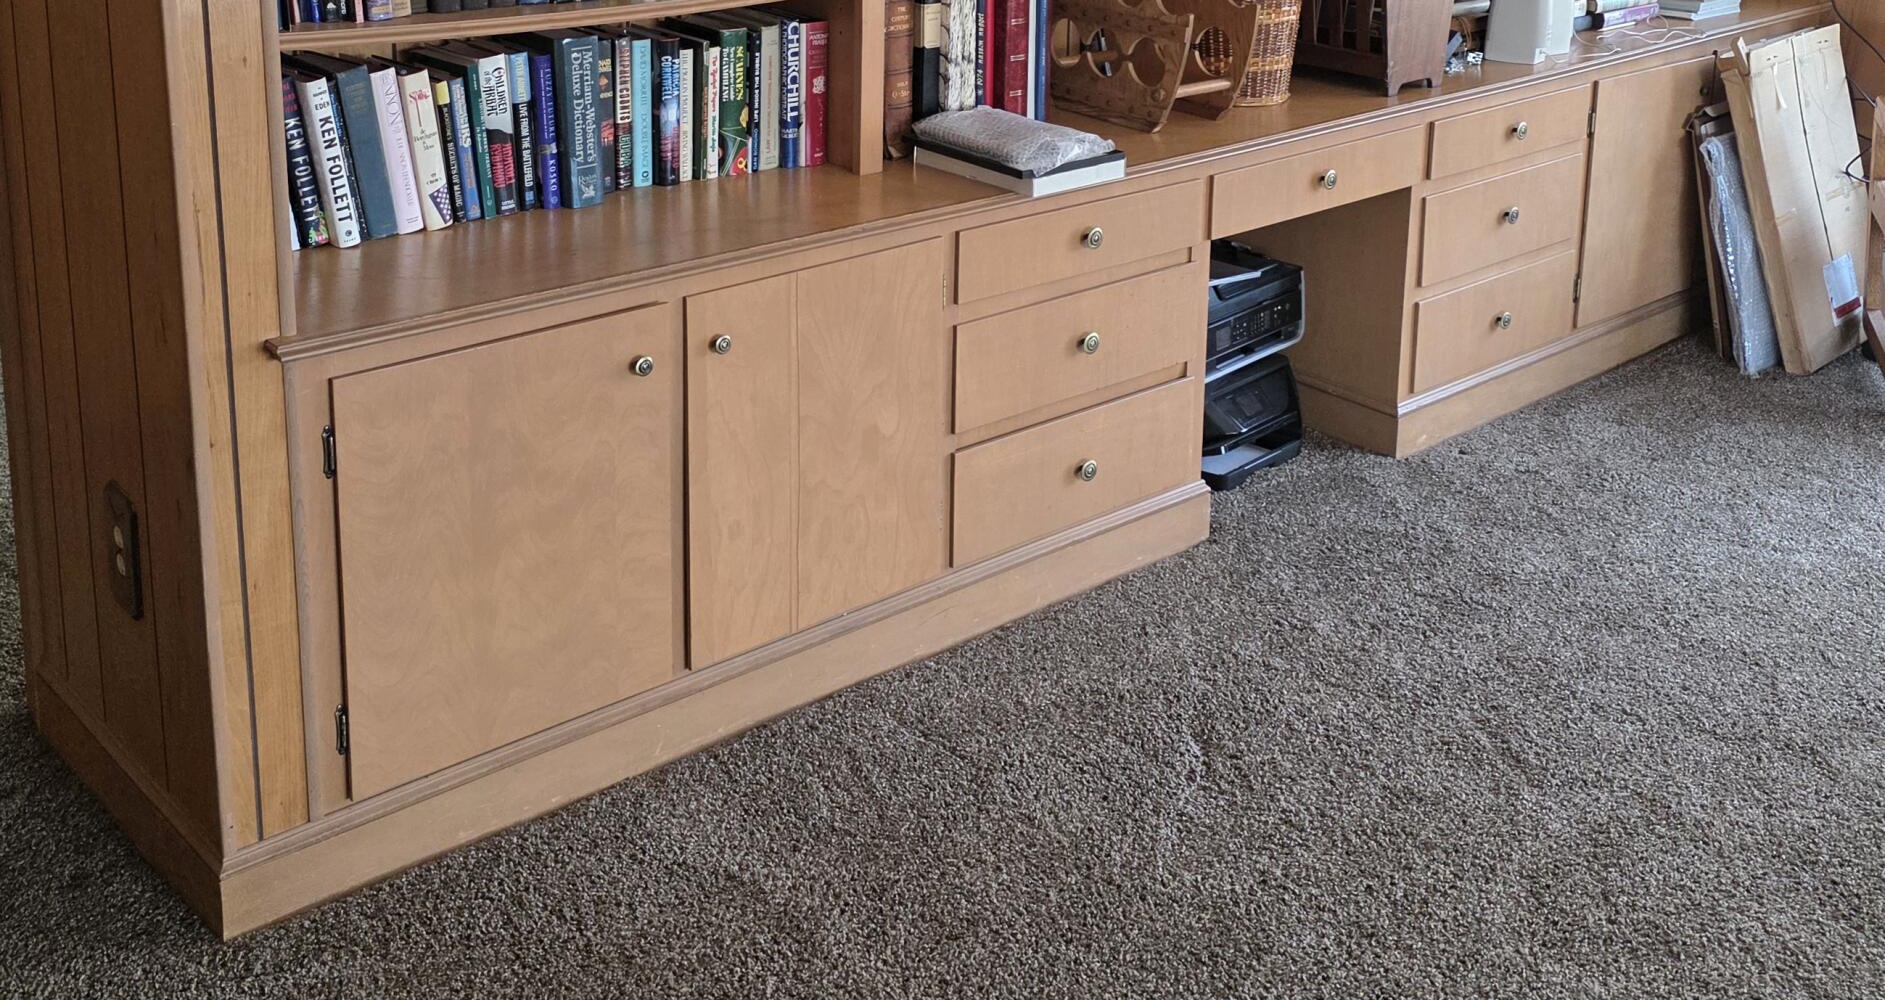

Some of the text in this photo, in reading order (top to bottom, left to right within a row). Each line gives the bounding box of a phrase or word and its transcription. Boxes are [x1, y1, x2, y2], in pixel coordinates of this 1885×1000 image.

[492, 67, 508, 115] CHILDREN
[545, 68, 553, 96] FUZZY
[619, 47, 632, 122] STEPHEN COONTS
[661, 56, 673, 101] CORNWELL
[671, 59, 680, 97] PATRICIA
[722, 47, 730, 102] To GAMBLING
[735, 45, 745, 100] SCARNE'S
[787, 21, 800, 122] CHURCHILL
[314, 101, 329, 110] EDEN
[482, 85, 498, 116] ARBAT
[547, 102, 556, 138] FUTURE
[570, 52, 586, 163] Deluxe Dictionary
[582, 50, 597, 162] Merriam-Webster's
[318, 116, 338, 149] KEN
[519, 104, 533, 187] LIVE FROM THE BATTLEFIELD
[285, 117, 320, 222] KEN FOLLETT
[326, 154, 353, 223] FOLLETT
[447, 142, 464, 207] SECRETS OF MAGIC
[549, 160, 558, 191] KOSKO
